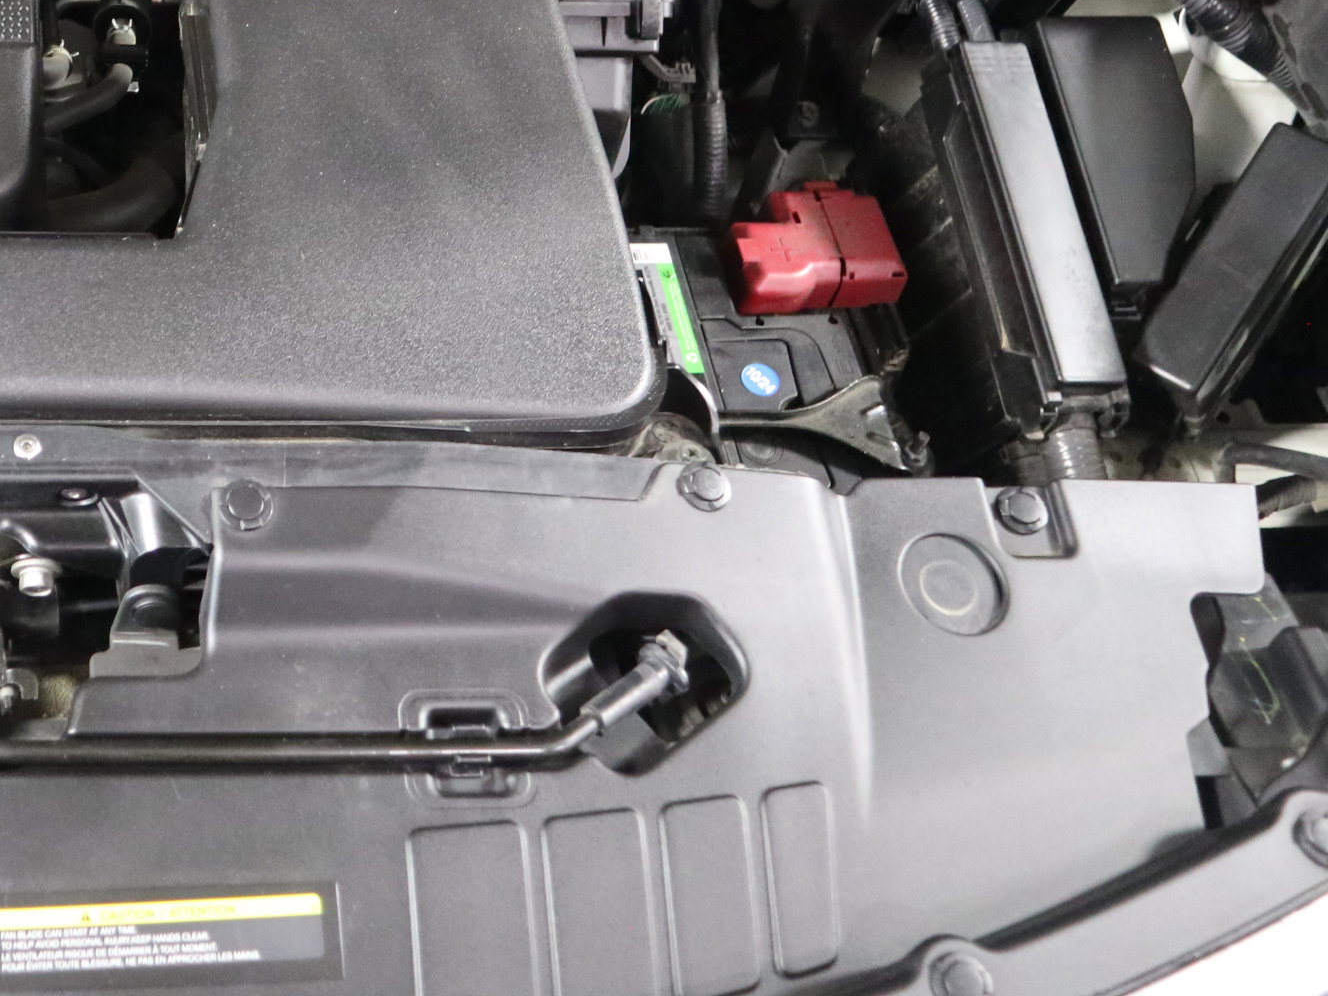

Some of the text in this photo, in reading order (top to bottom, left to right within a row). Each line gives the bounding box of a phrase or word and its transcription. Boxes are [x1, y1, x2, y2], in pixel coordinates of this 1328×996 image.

[746, 365, 777, 395] 10/24
[99, 908, 154, 921] CAUTION
[169, 905, 235, 917] ATTENTION
[1, 930, 16, 940] FAN
[17, 929, 43, 940] BLADE
[45, 928, 62, 938] CAN
[63, 927, 87, 937] START
[89, 926, 98, 936] AT
[100, 925, 116, 935] ANY
[1, 940, 12, 950] TO
[14, 939, 34, 949] HELP
[35, 938, 59, 948] AVOID
[61, 936, 102, 947] PERSONAL
[153, 932, 180, 943] HANDS
[1, 951, 11, 962] LE
[12, 949, 64, 961] VENTILATEUR
[64, 948, 94, 959] RISQUE
[95, 947, 106, 958] DE
[161, 943, 180, 953] TOUT
[1, 961, 25, 973] POUR
[54, 959, 79, 970] TOUTE
[125, 956, 136, 966] NE
[138, 956, 153, 965] PAS
[155, 955, 166, 964] EN
[167, 952, 216, 964] APPROCHER
[218, 951, 232, 961] LES
